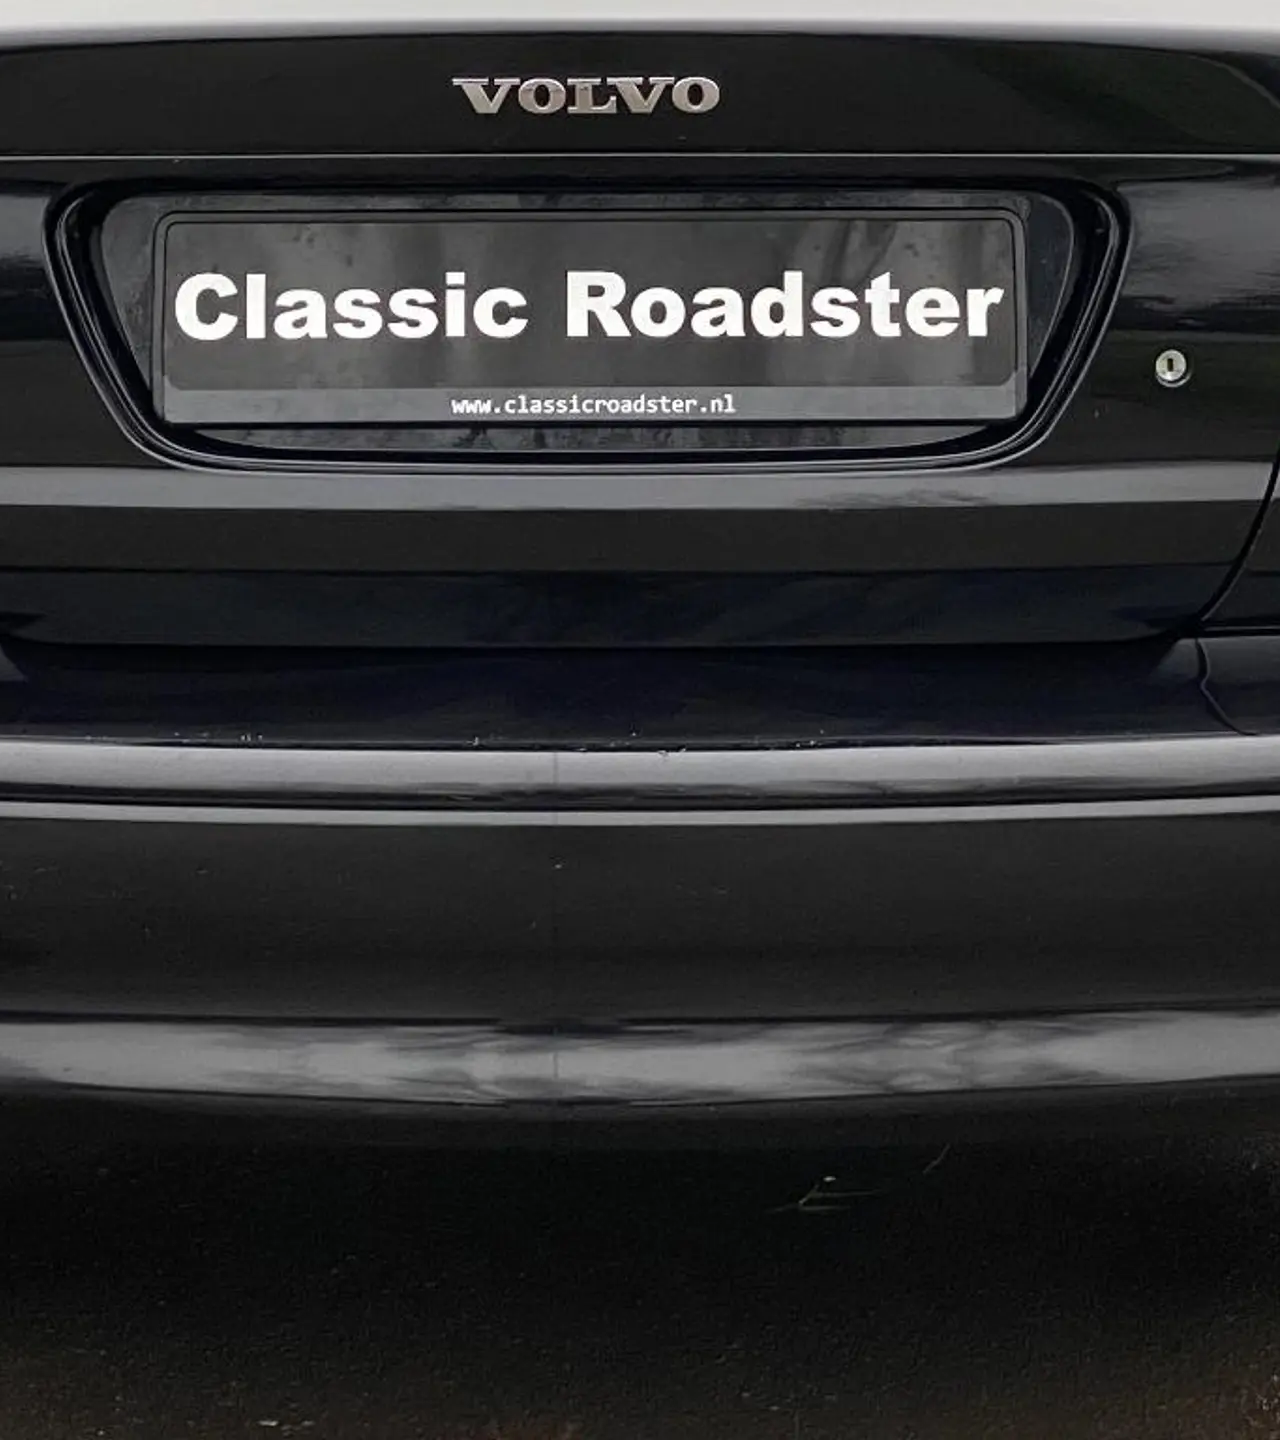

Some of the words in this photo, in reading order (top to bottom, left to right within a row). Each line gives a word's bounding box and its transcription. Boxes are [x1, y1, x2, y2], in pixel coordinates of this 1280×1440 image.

[451, 76, 721, 115] VOLVO
[174, 271, 529, 341] Classic
[566, 270, 1005, 339] Roadster
[450, 392, 738, 420] www.classicroadster.nl
